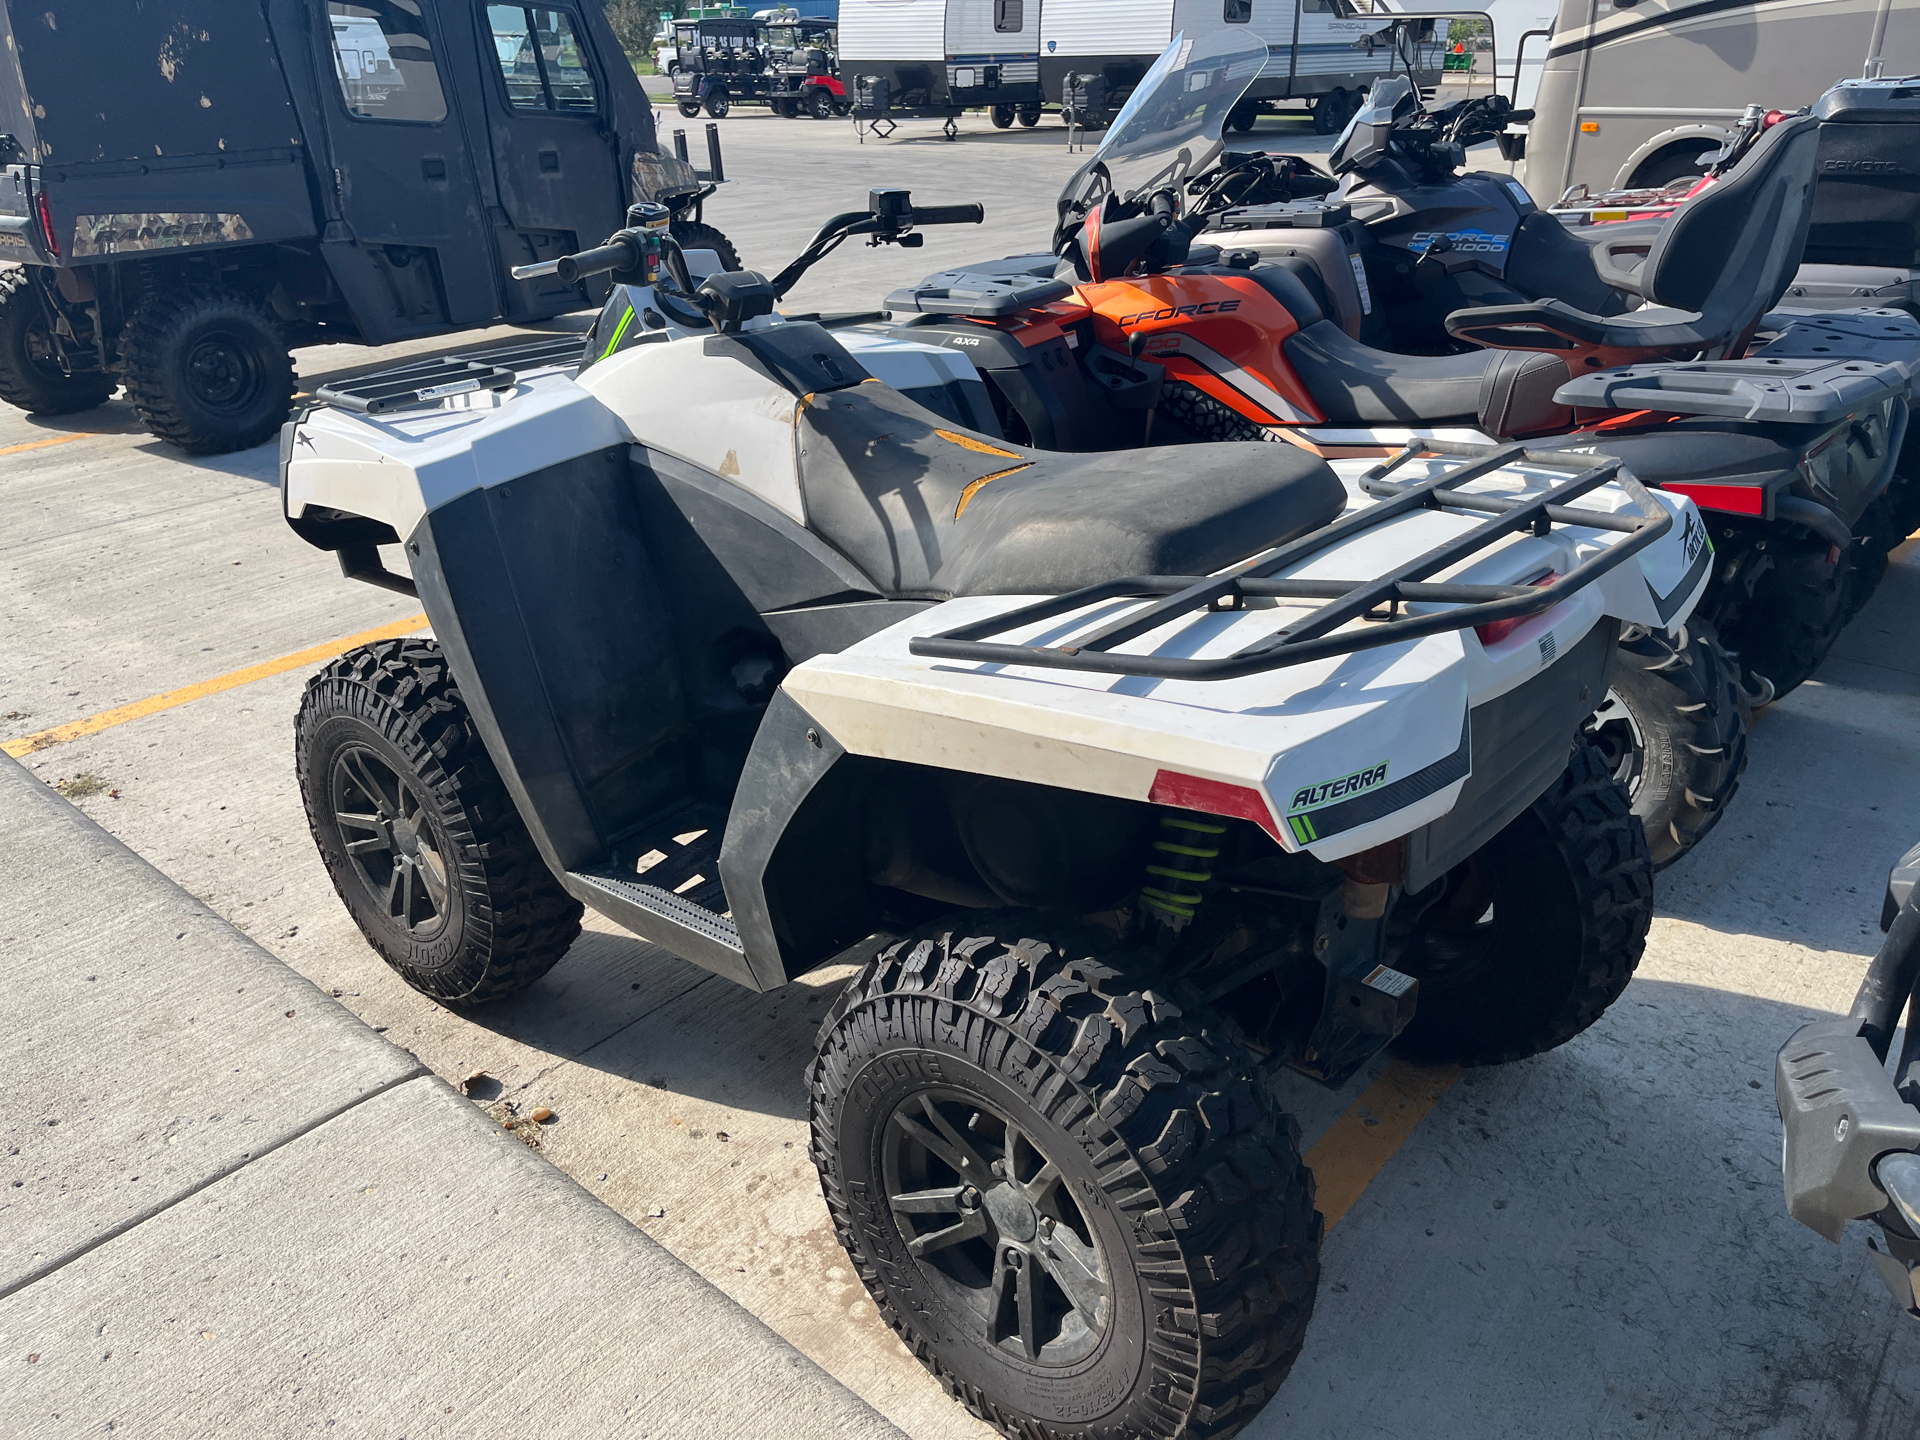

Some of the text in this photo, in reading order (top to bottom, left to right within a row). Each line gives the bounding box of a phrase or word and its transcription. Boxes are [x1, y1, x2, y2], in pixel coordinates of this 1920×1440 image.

[729, 36, 743, 48] LOW
[93, 221, 226, 243] RANGER
[1411, 231, 1510, 243] CFORCE
[1118, 299, 1242, 328] CFORCE
[1291, 763, 1388, 809] ALTERRA
[852, 1052, 945, 1119] COYOTE
